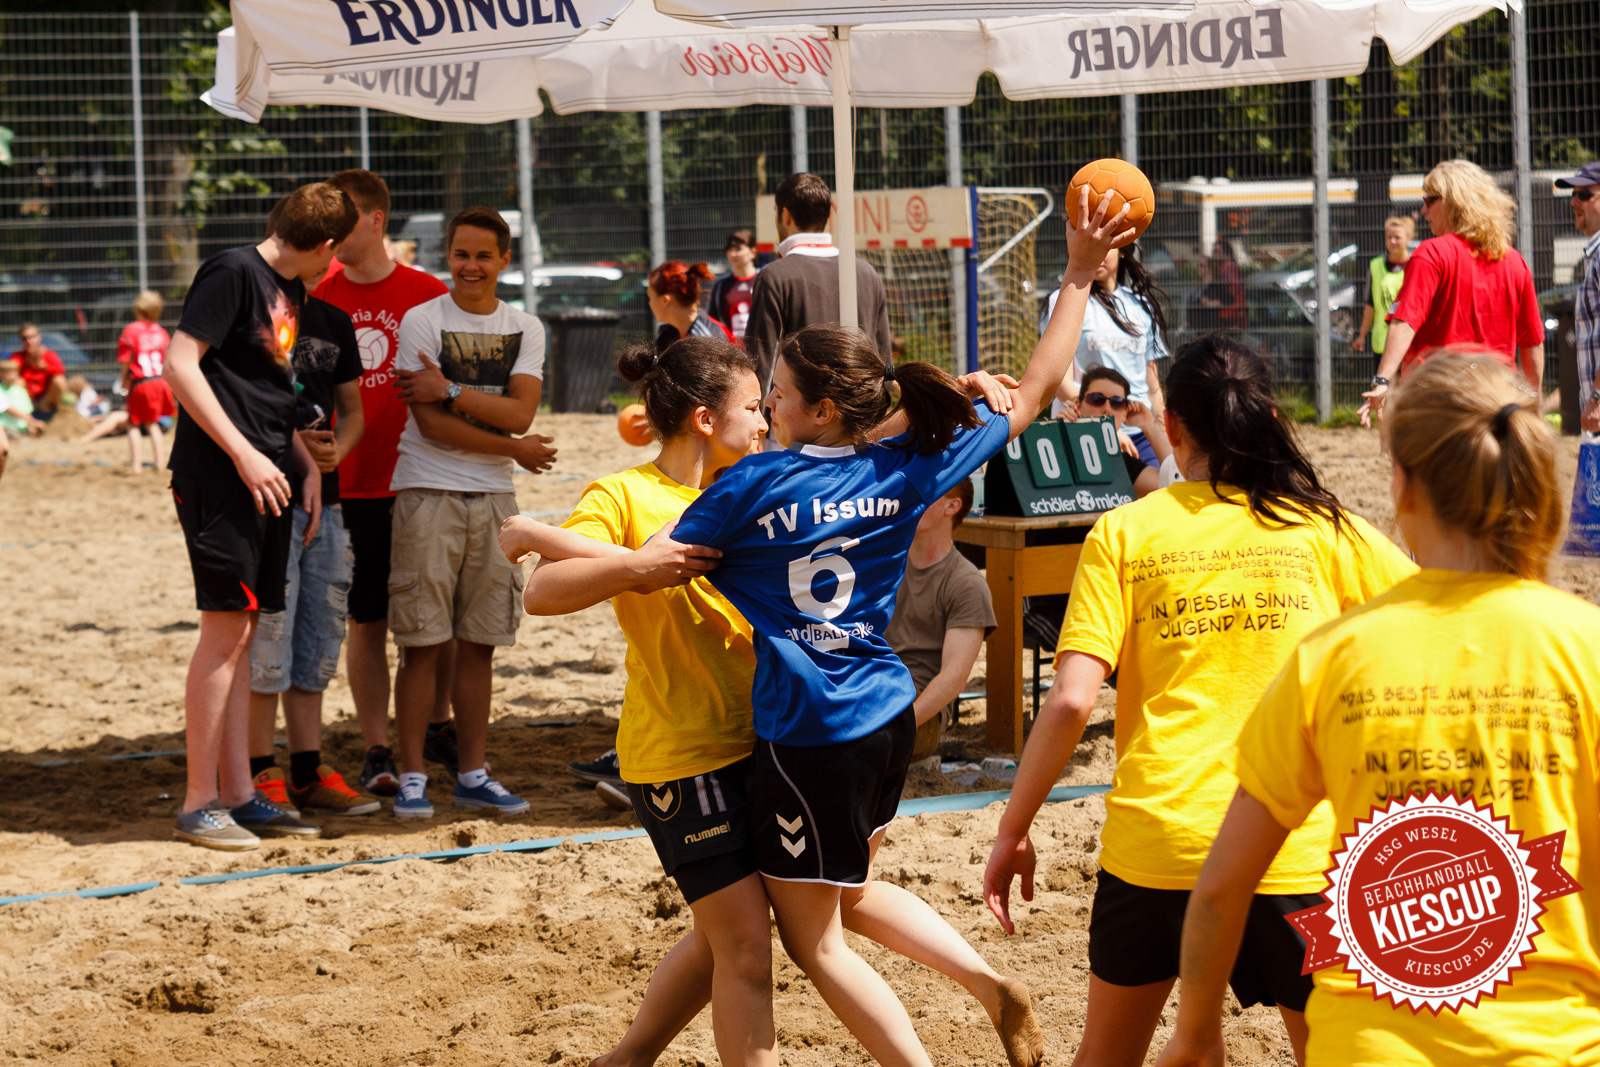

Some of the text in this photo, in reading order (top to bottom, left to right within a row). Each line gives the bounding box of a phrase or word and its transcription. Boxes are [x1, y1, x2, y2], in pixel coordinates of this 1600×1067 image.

[1036, 438, 1061, 479] 0
[1079, 434, 1102, 475] 0
[1101, 422, 1119, 455] 0
[1030, 493, 1132, 514] schöler micke
[757, 497, 900, 540] TV Issum
[1161, 550, 1206, 564] BESTE
[1212, 549, 1231, 560] AM
[788, 536, 861, 620] 6
[1148, 567, 1175, 579] KANN
[1179, 565, 1196, 574] IHN
[1199, 562, 1227, 571] NOCH
[1231, 559, 1270, 570] BESSER
[1176, 593, 1246, 615] DIESEM
[1160, 612, 1288, 639] JUGEND ADE!
[1383, 685, 1439, 702] BESTE
[1447, 686, 1471, 700] AM
[1365, 706, 1401, 718] KANN
[1397, 748, 1485, 772] DIESEM
[1480, 777, 1534, 801] ADE!
